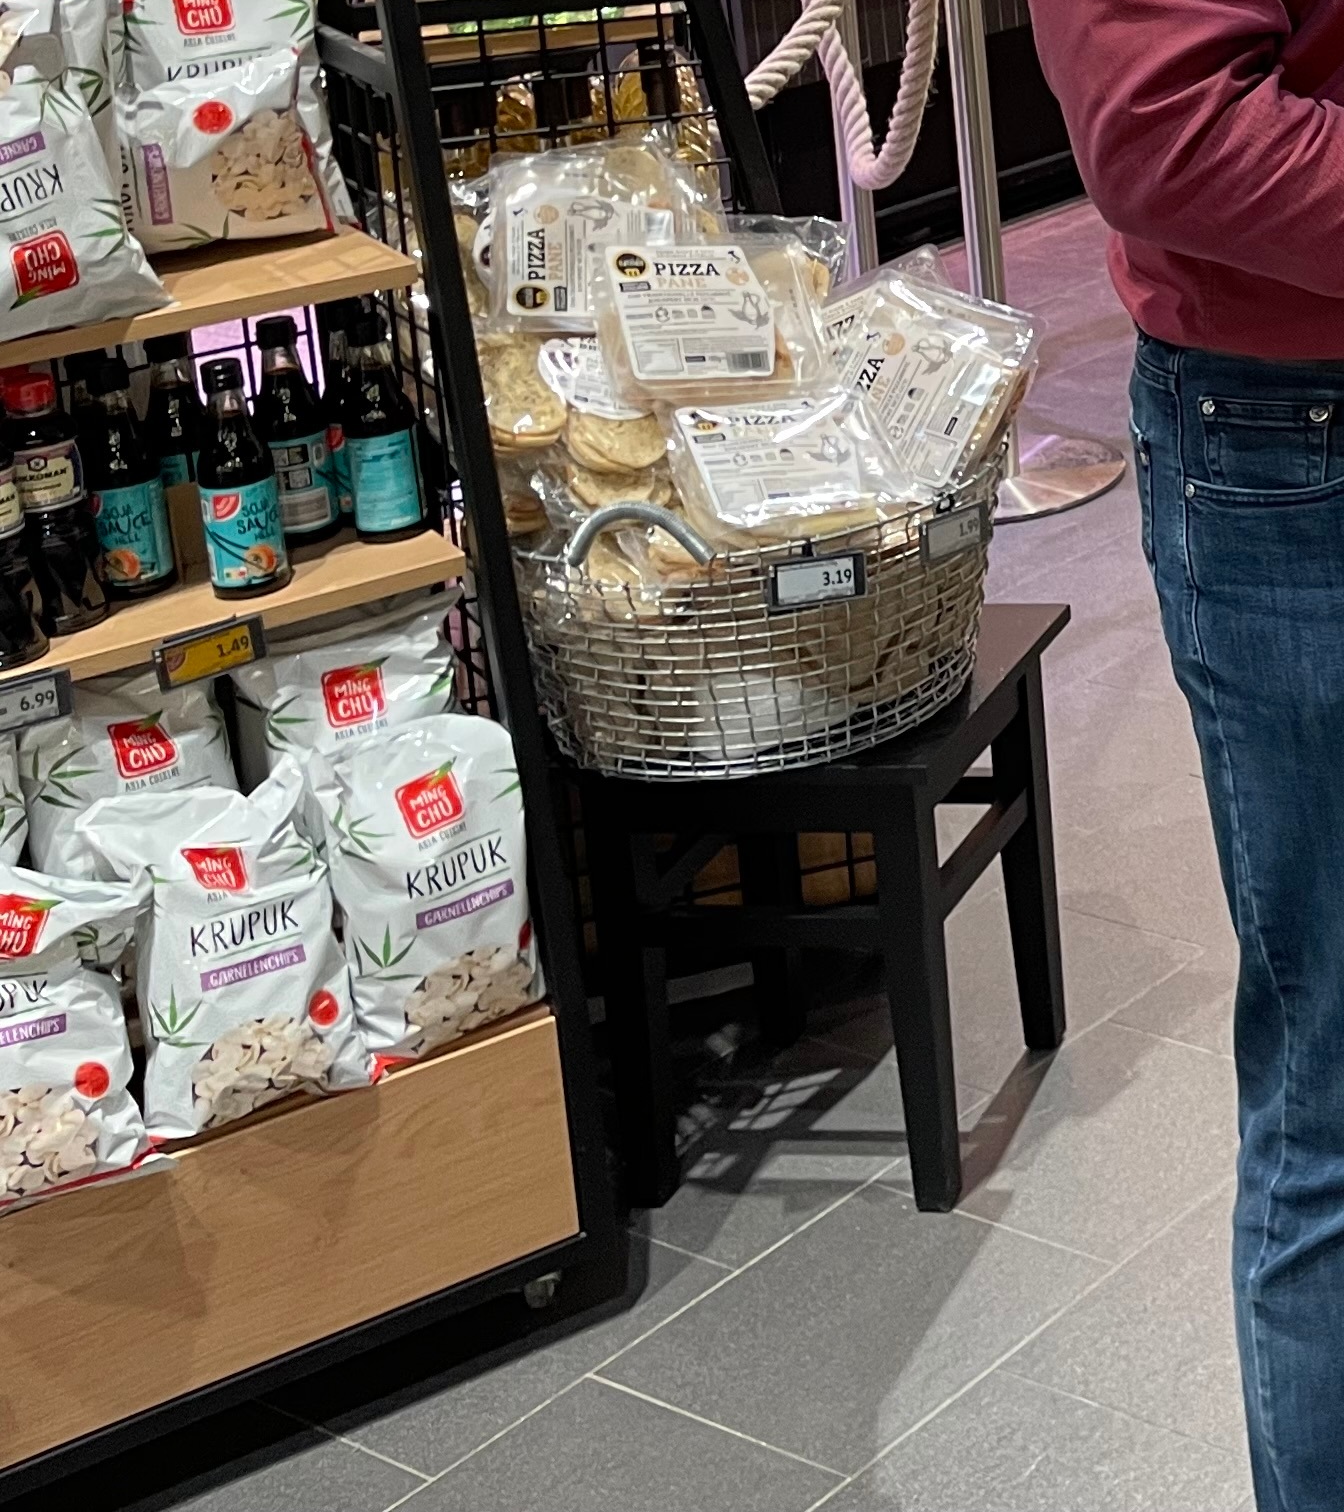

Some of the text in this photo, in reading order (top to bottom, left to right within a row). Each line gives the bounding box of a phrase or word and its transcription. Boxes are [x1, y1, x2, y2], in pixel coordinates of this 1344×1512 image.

[527, 228, 546, 281] PIZZA
[28, 261, 66, 283] MING
[653, 262, 720, 276] PIZZA
[657, 277, 707, 288] PANE
[856, 358, 885, 393] ZZA
[729, 414, 797, 425] PIZZA
[958, 517, 979, 537] 1.99
[822, 568, 852, 586] 3.19
[216, 635, 250, 658] 1.49
[334, 677, 371, 698] MING
[19, 690, 56, 712] 6.99
[123, 733, 156, 749] MING
[409, 785, 447, 812] MING
[406, 836, 508, 900] KRUPUK
[424, 884, 508, 926] GARNELENCHIPS
[190, 900, 299, 957] KRUPUK
[209, 950, 300, 987] GARNELENCHIPS
